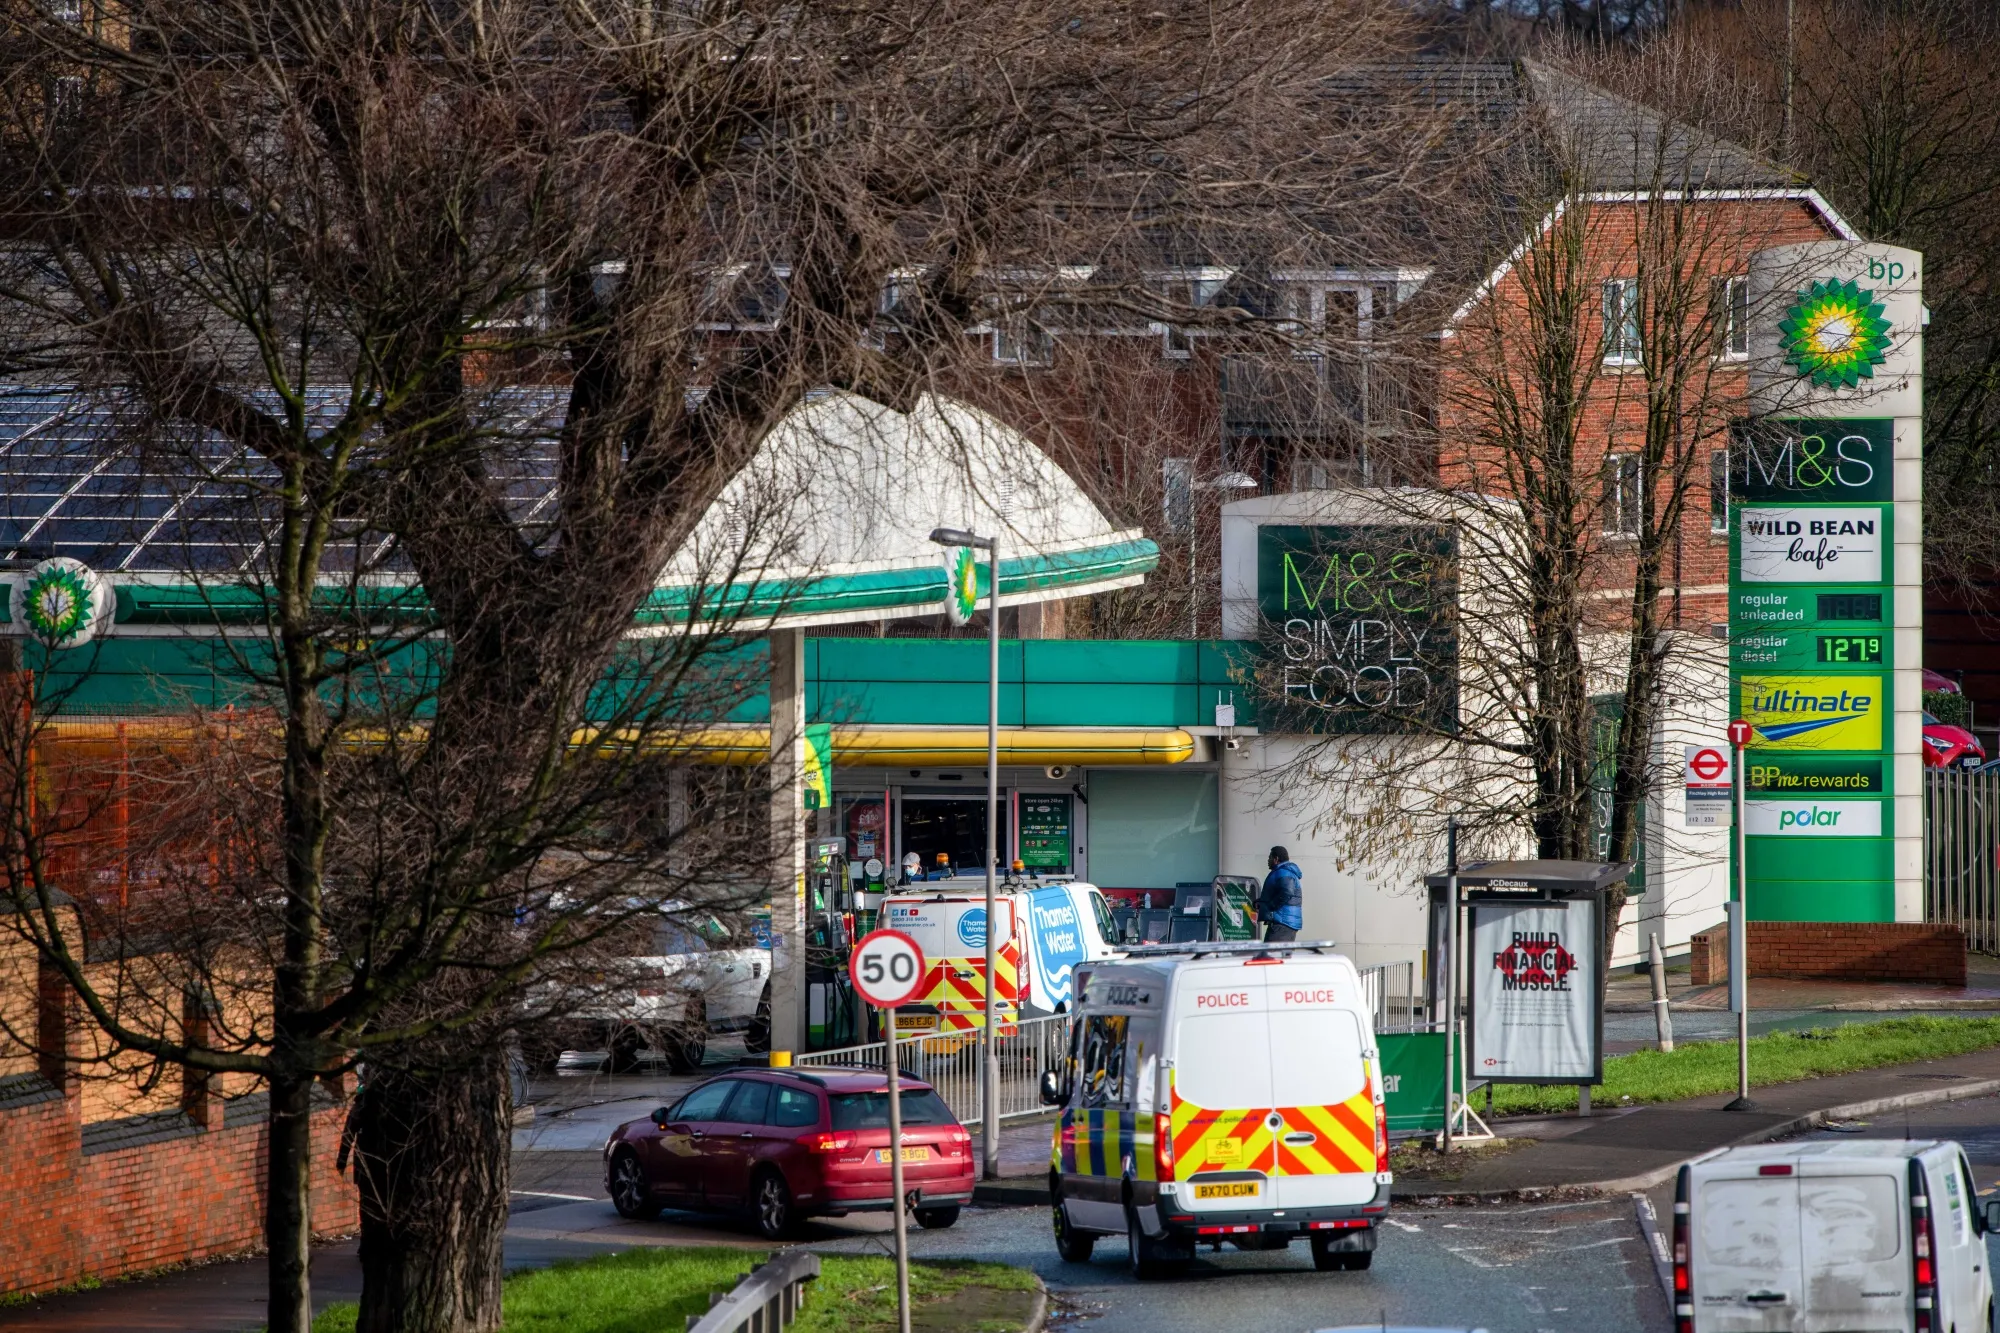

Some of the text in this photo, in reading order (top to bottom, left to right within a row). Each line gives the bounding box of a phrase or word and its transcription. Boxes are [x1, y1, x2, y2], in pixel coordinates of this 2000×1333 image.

[1869, 257, 1904, 285] bp
[1746, 435, 1873, 487] M&S
[1747, 520, 1874, 536] WILD BEAN
[1284, 552, 1430, 613] M&S
[1740, 593, 1788, 607] regular
[1740, 609, 1804, 621] unleaded
[1284, 618, 1430, 661] SIMPLY
[1740, 635, 1788, 649] regular
[1740, 651, 1777, 662] diesel
[1284, 665, 1430, 708] FOOD
[1753, 690, 1871, 712] ultimate
[1732, 724, 1747, 743] T
[1804, 772, 1869, 787] rewards
[1779, 806, 1842, 831] polar
[1487, 879, 1529, 888] JCDecaux
[1034, 905, 1075, 930] Thames
[1044, 930, 1076, 955] Water
[1512, 931, 1559, 949] BUILD
[863, 953, 914, 983] 50
[1493, 951, 1578, 970] FINANCIAL
[1502, 973, 1571, 991] MUSCLE.
[1106, 986, 1139, 1005] POLICE
[1197, 990, 1335, 1008] POLICE POLICE
[896, 1016, 915, 1026] B66
[1200, 1185, 1230, 1197] BX70
